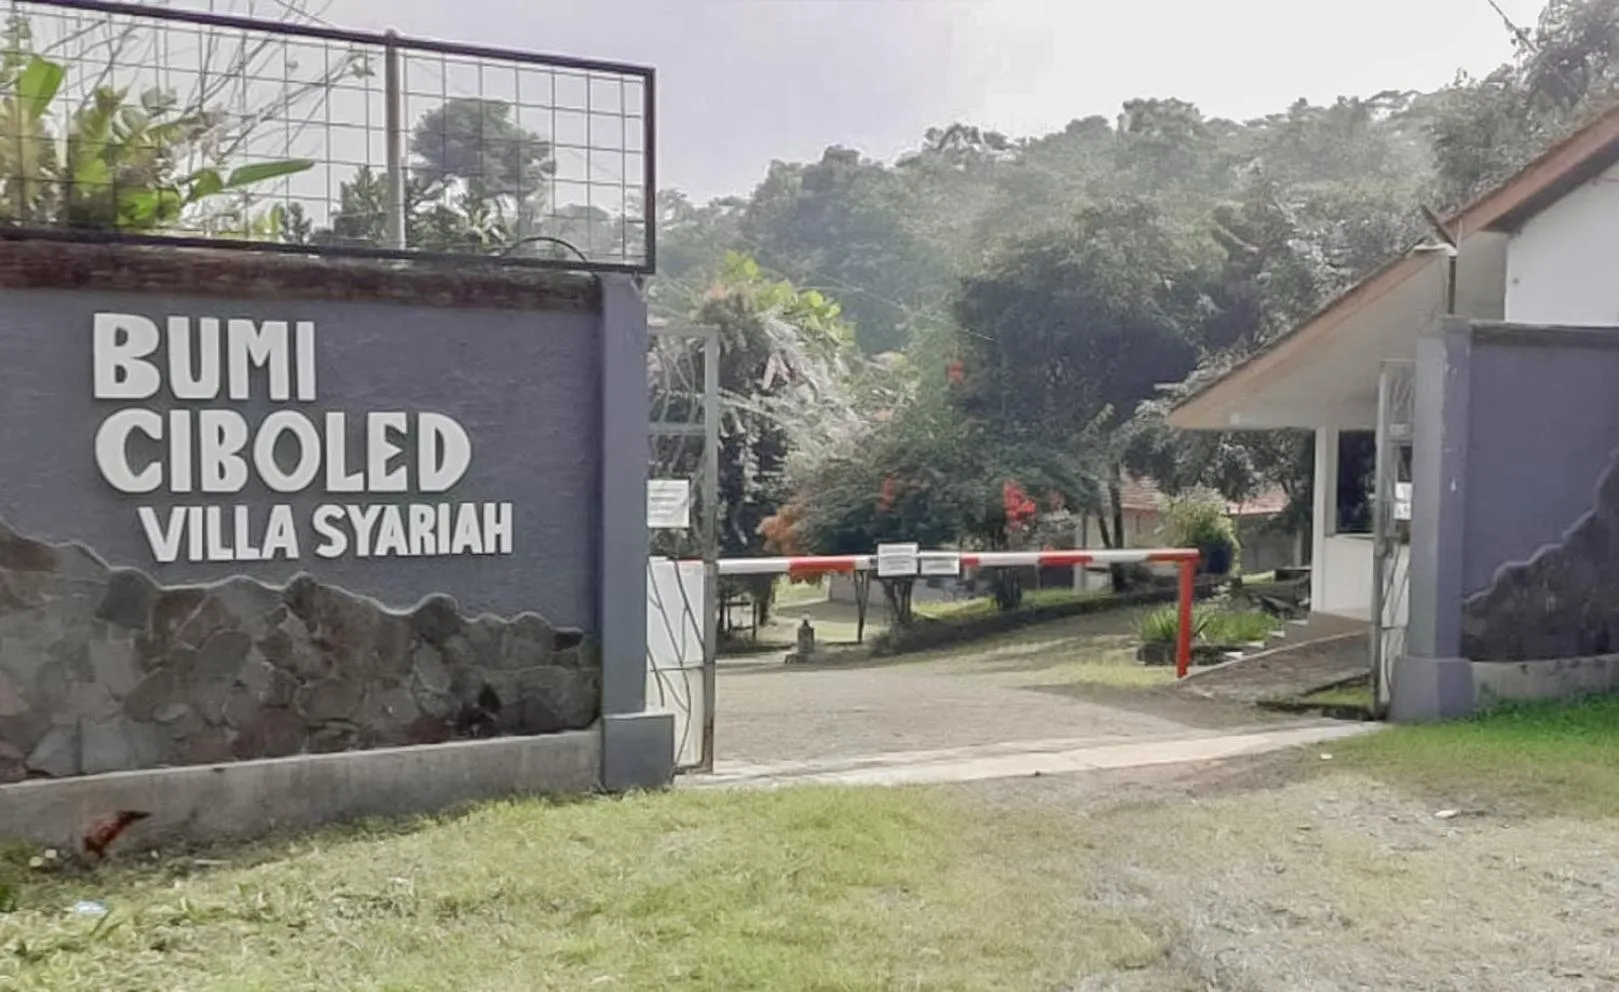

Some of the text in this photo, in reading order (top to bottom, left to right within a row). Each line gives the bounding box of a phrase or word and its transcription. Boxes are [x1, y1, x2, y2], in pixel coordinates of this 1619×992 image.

[93, 312, 315, 400] BUMI
[95, 408, 471, 492] CIBOLED
[138, 502, 513, 562] VILLA SYARIAH
